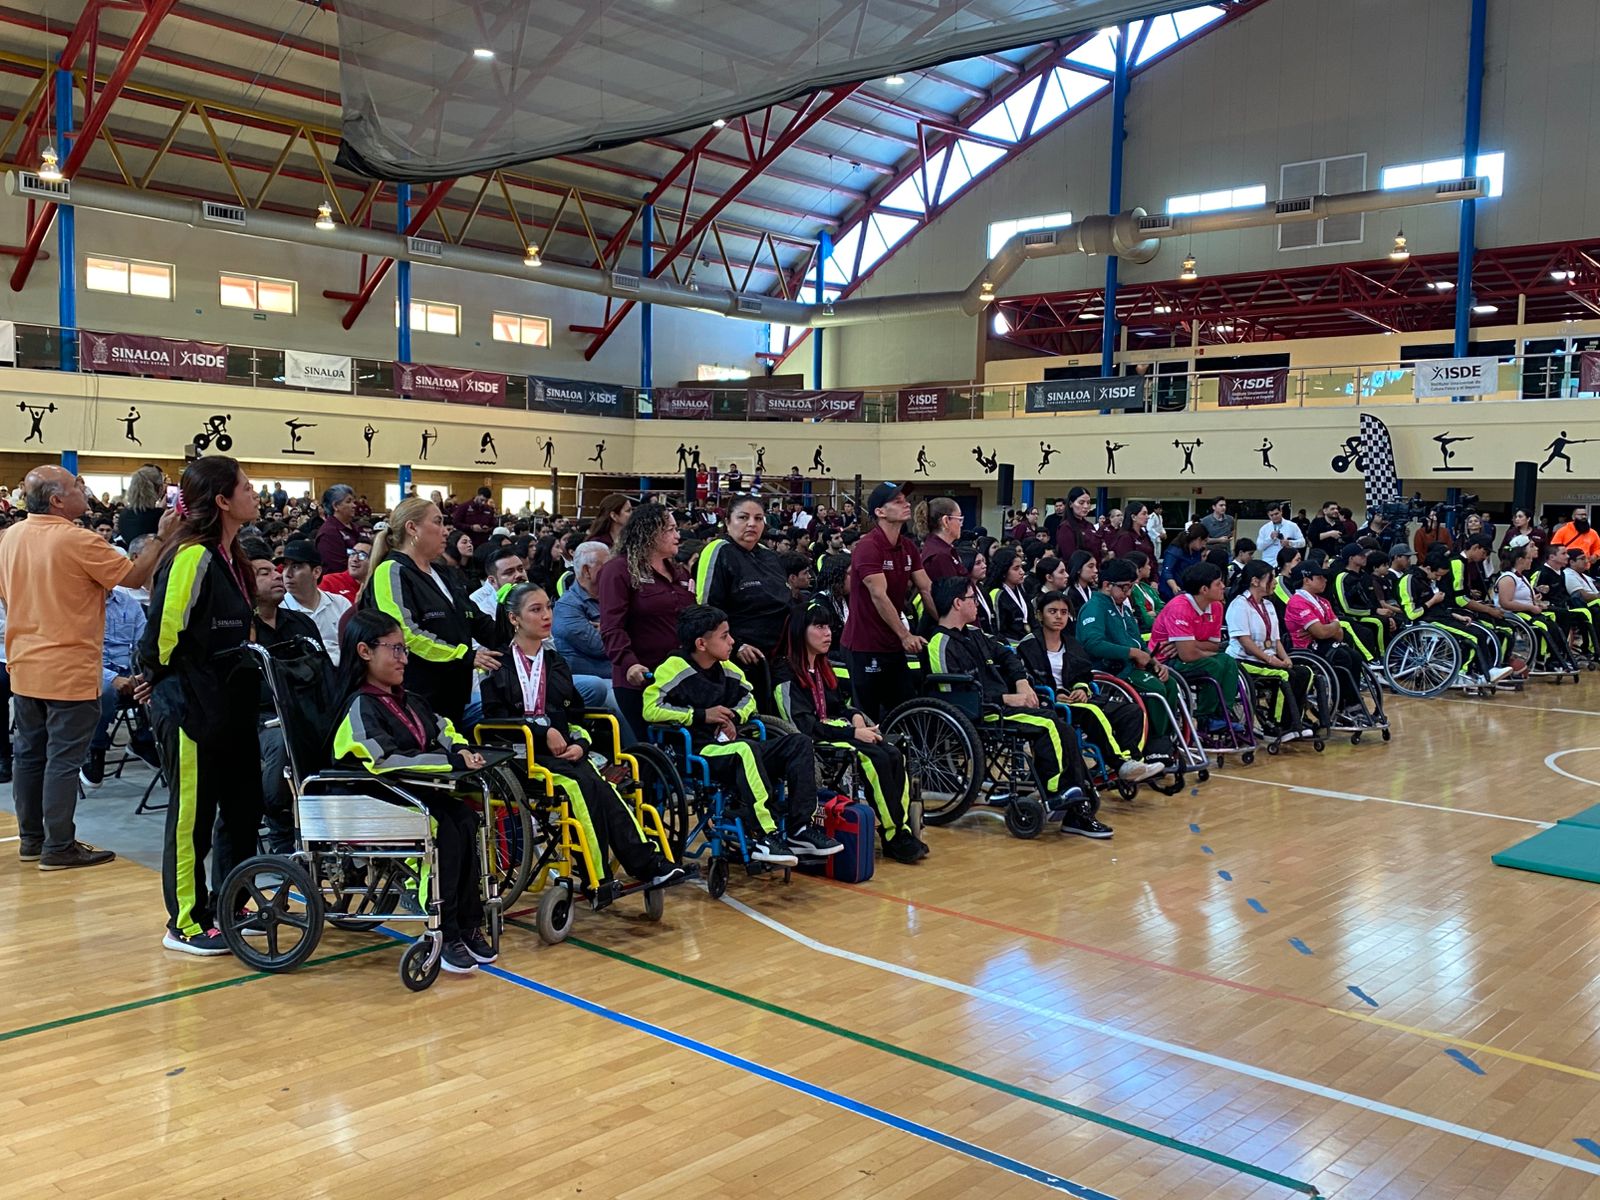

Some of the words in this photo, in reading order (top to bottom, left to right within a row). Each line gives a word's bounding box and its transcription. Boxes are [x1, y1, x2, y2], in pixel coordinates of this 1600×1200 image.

[112, 347, 169, 362] SINALOA
[304, 366, 345, 378] SINALOA
[415, 376, 459, 388] SINALOA
[546, 388, 582, 400] SINALOA
[1047, 390, 1090, 401] SINALOA
[671, 400, 709, 408] SINALOA
[768, 399, 812, 409] SINALOA
